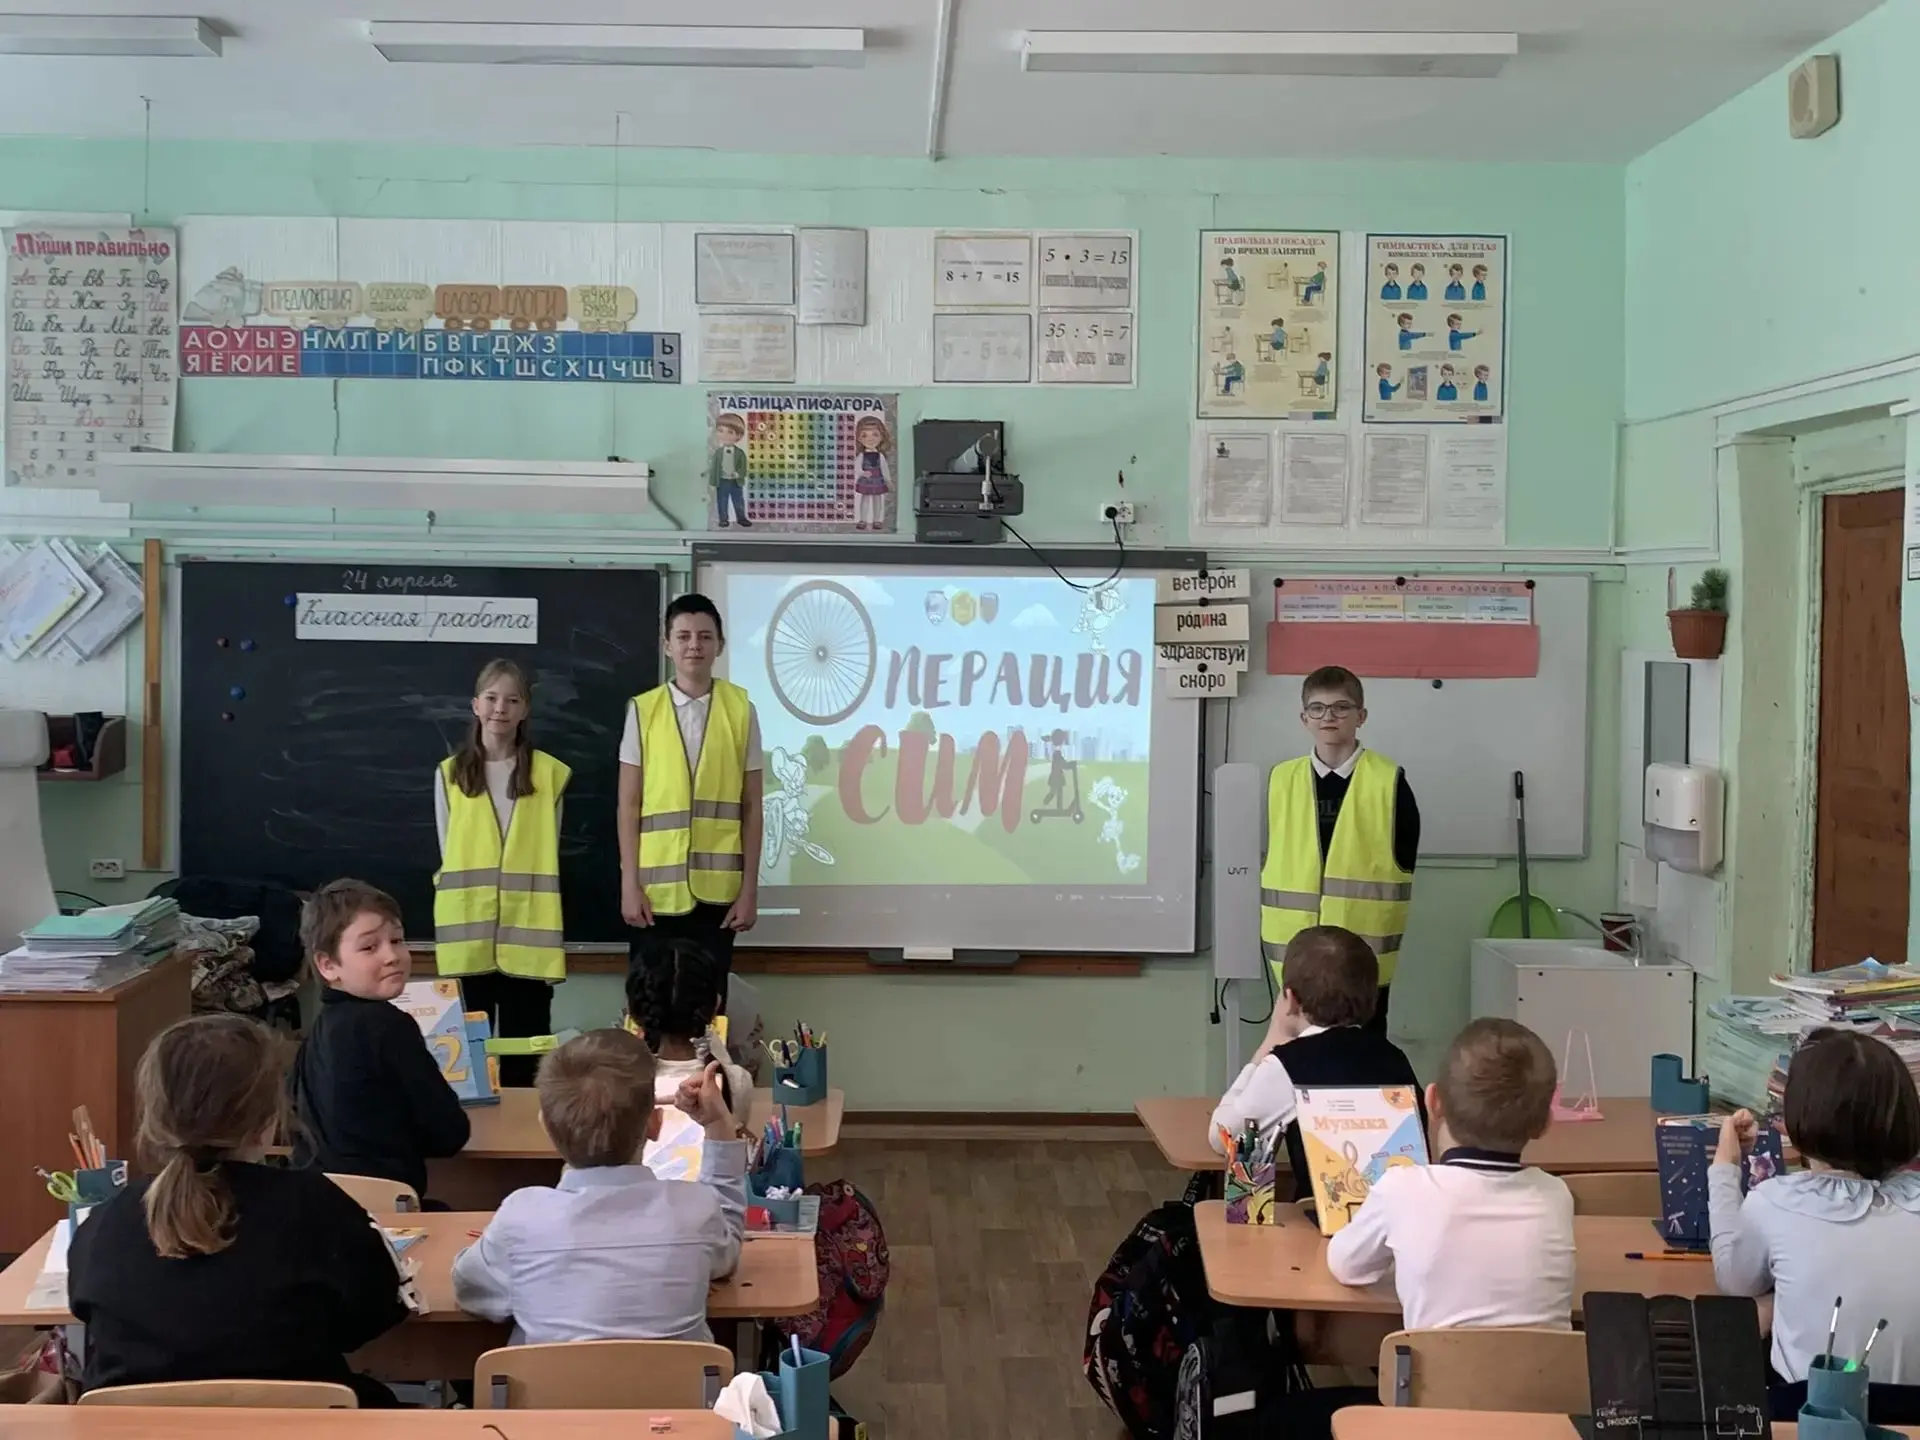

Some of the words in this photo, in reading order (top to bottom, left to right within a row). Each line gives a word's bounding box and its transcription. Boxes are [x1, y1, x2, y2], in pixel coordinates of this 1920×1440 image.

[75, 240, 170, 257] ПРАВИЛЬНО
[1045, 248, 1056, 263] 5
[1079, 249, 1090, 264] 3
[1110, 250, 1129, 265] 15
[946, 271, 954, 282] 8
[976, 271, 983, 282] 7
[1006, 271, 1020, 283] 15
[1045, 323, 1067, 338] 35
[1087, 324, 1098, 339] 5
[1119, 325, 1130, 340] 7
[718, 396, 796, 412] ТАБЛИЦА
[797, 397, 884, 412] ПИФАГОРА
[342, 569, 368, 591] 24
[376, 572, 458, 593] апреля
[300, 598, 420, 627] Классная
[428, 600, 533, 638] работа
[1160, 644, 1245, 666] здравствуй
[838, 724, 1030, 834] СИМ
[1312, 1115, 1389, 1134] Музыка
